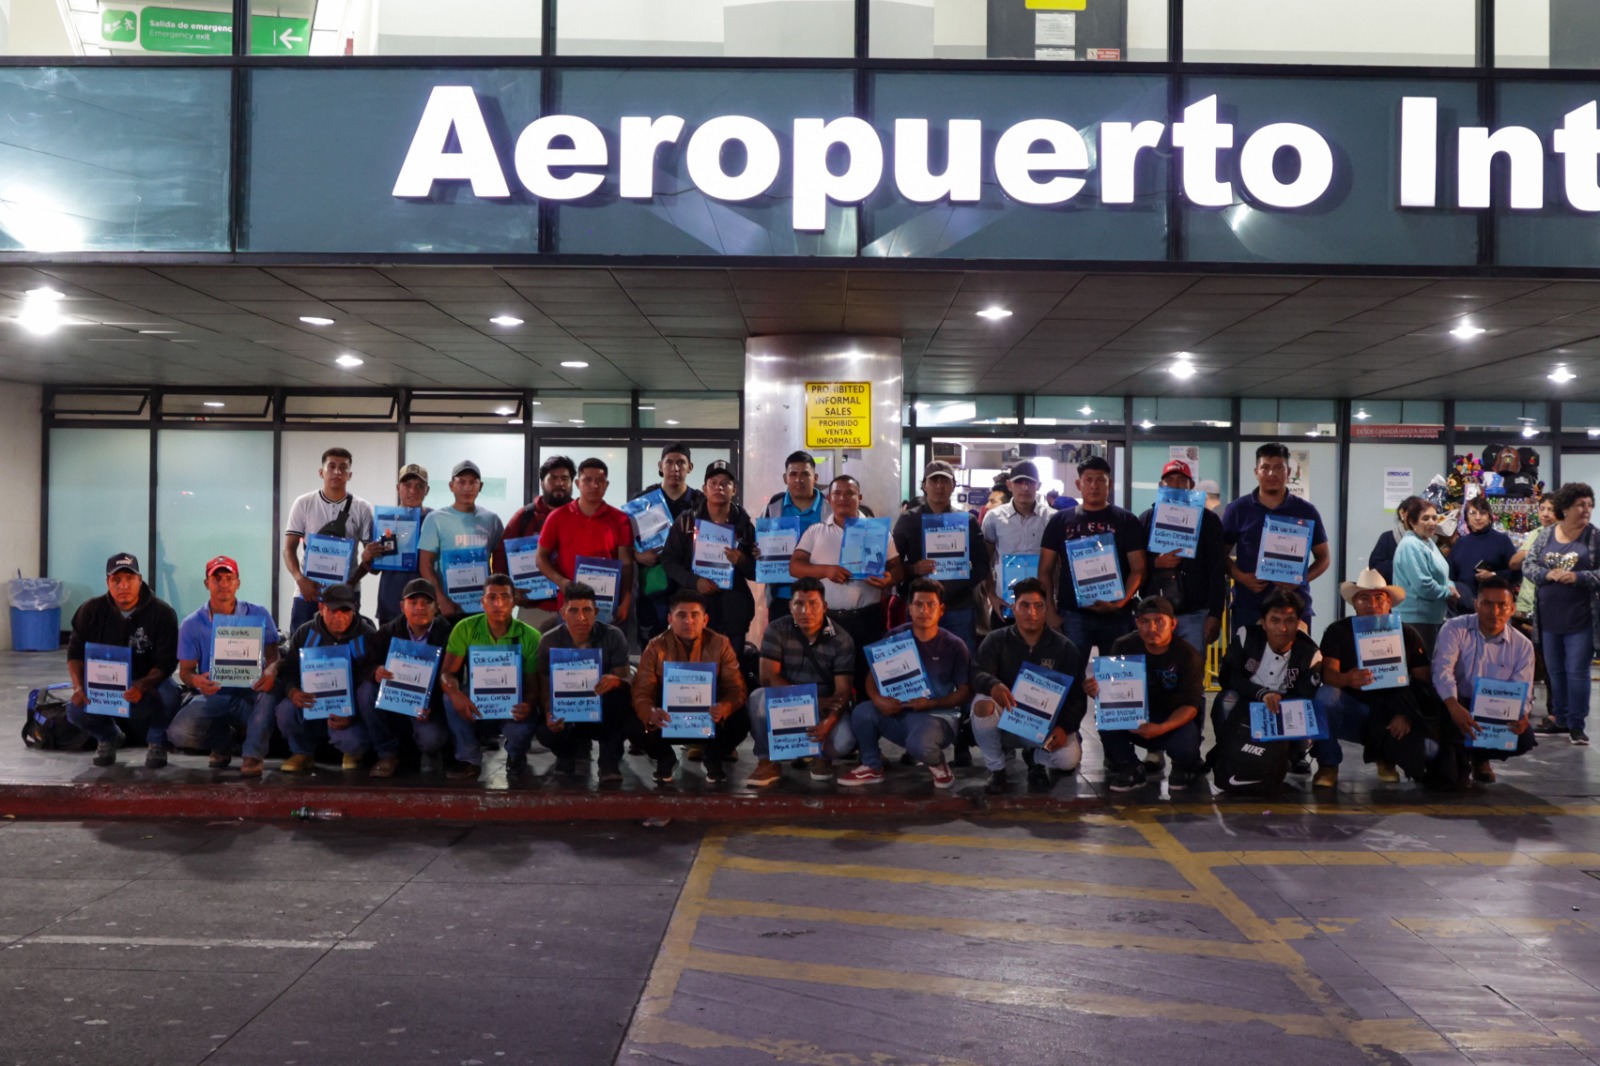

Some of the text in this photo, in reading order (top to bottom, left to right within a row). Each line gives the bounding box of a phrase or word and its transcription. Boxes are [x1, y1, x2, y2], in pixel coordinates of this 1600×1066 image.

[149, 19, 176, 28] Salida
[177, 21, 189, 29] de
[149, 29, 210, 41] Emergency exit
[392, 85, 1600, 231] Aeropuerto Int
[811, 385, 865, 394] PROHIBITED
[815, 396, 861, 405] INFORMAL
[825, 407, 852, 416] SALES
[818, 419, 859, 427] PROHIBIDO
[825, 428, 853, 436] VENTAS
[816, 437, 862, 445] INFORMALES
[1241, 743, 1266, 756] NIKE
